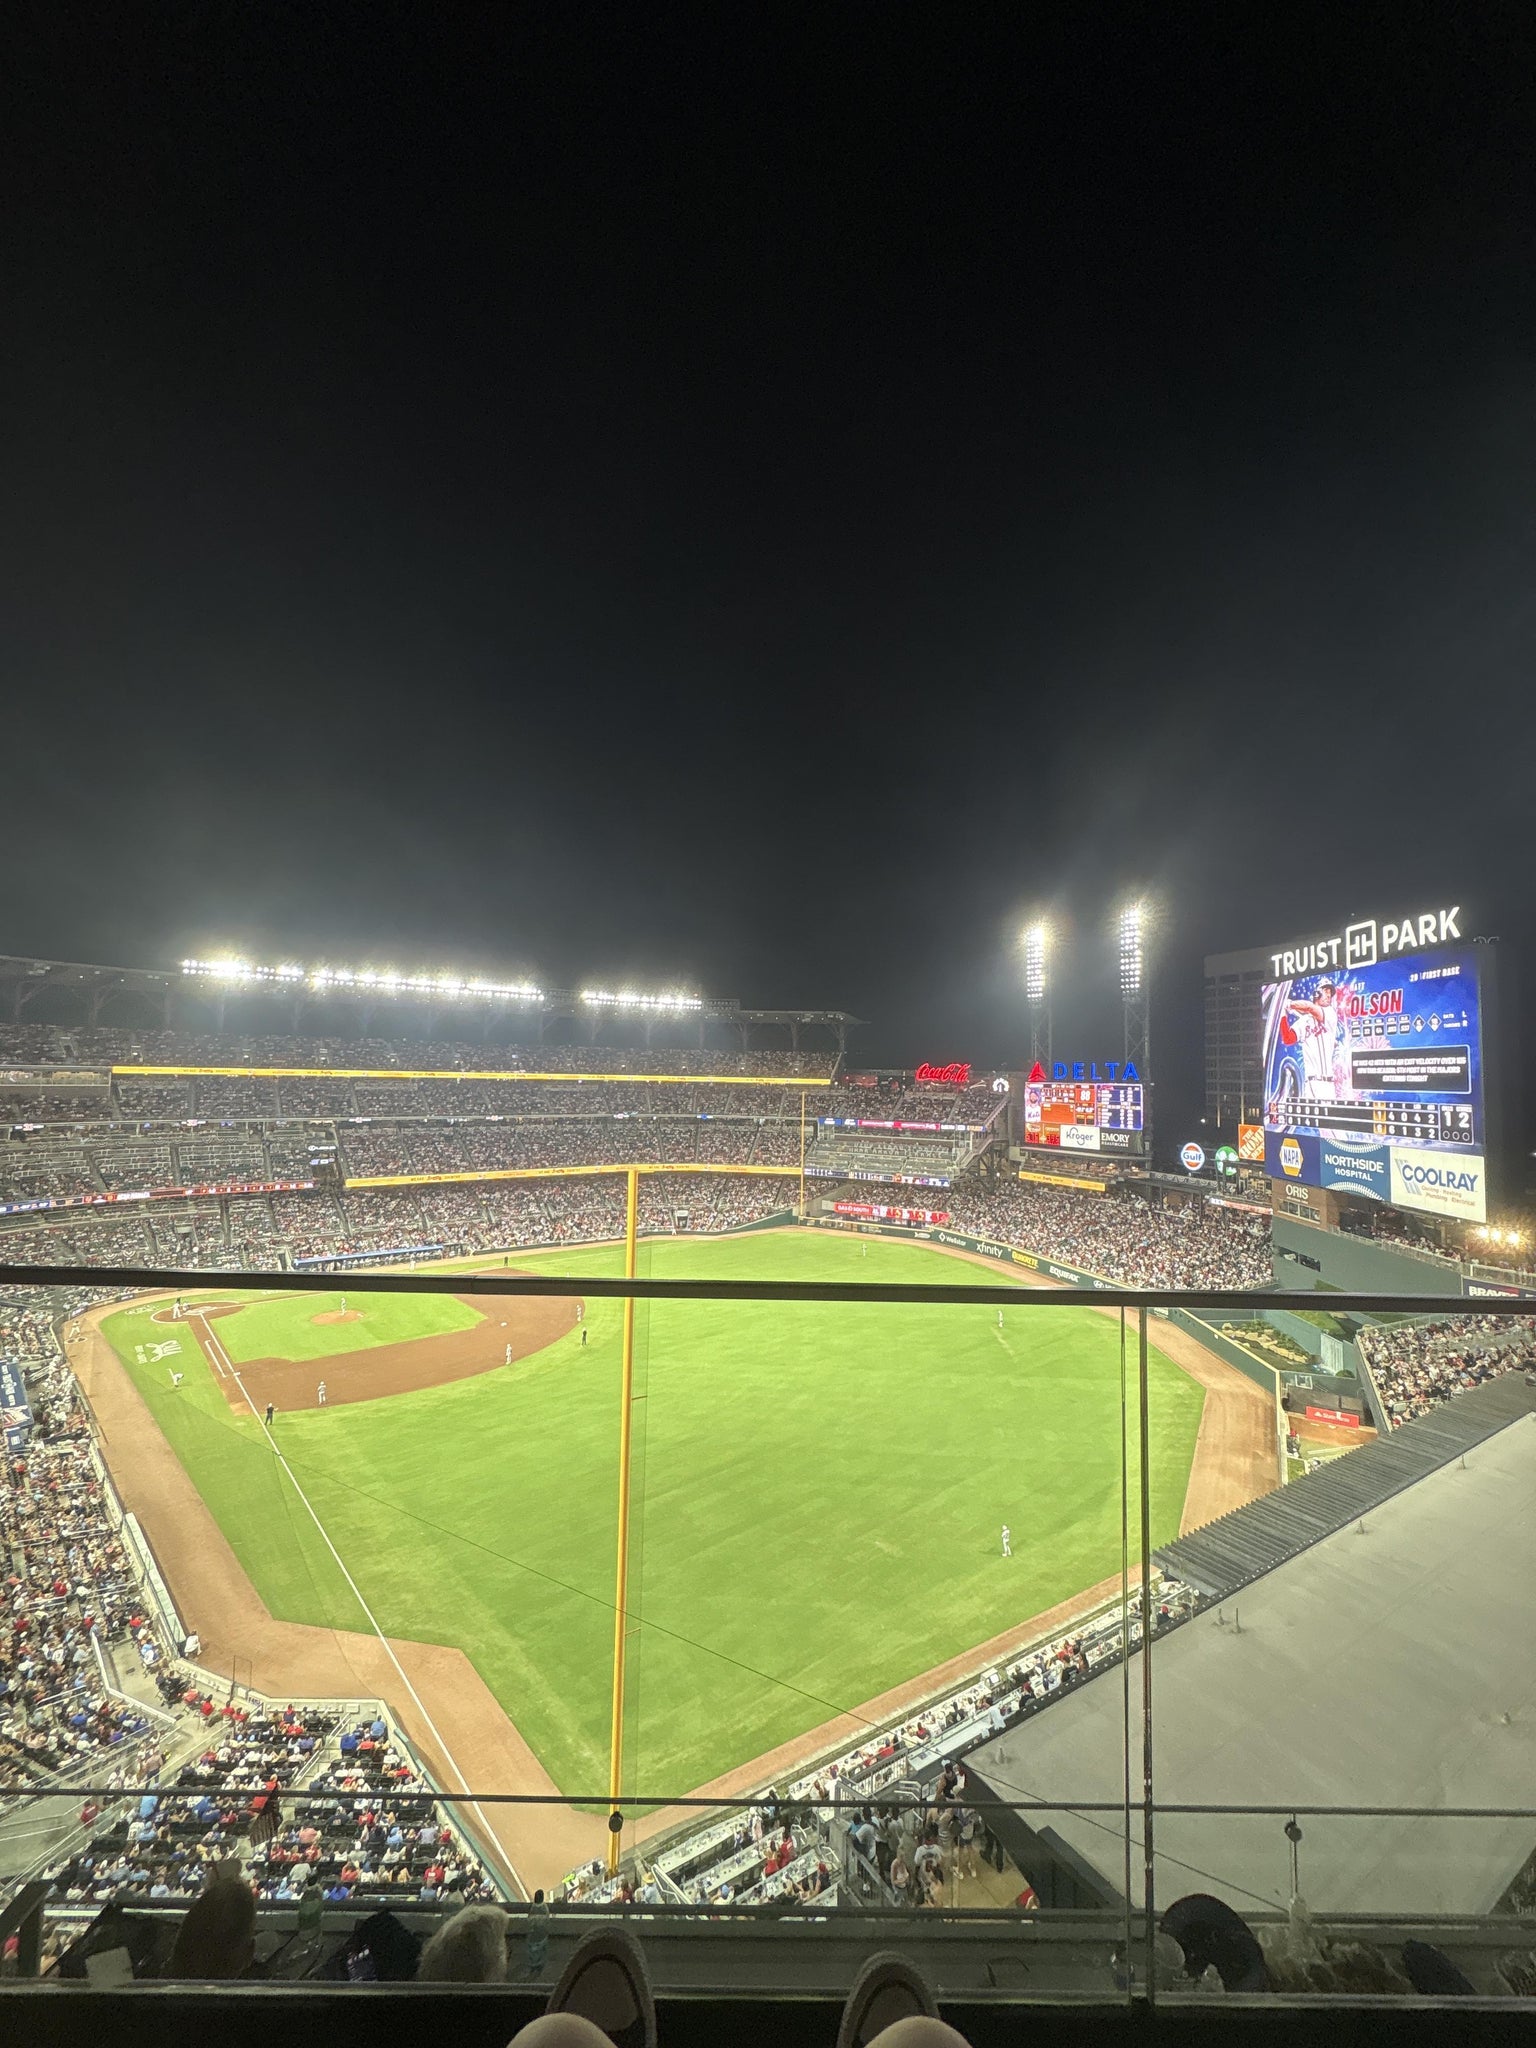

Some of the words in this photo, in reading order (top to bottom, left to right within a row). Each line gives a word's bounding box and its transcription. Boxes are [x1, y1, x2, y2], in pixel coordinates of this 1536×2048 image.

[1271, 938, 1342, 977] TRUIST
[1382, 906, 1462, 954] PARK
[1422, 969, 1441, 981] FIRST
[1442, 966, 1460, 977] BASE
[1350, 988, 1404, 1018] OLSON
[1462, 1010, 1467, 1018] L
[1053, 1062, 1139, 1081] DELTA
[1288, 1105, 1293, 1113] 0
[1296, 1105, 1301, 1114] 0
[1306, 1106, 1310, 1114] 0
[1314, 1106, 1319, 1115] 0
[1388, 1112, 1395, 1120] 4
[1401, 1112, 1407, 1121] 0
[1414, 1113, 1421, 1122] 4
[1428, 1114, 1435, 1123] 2
[1444, 1112, 1451, 1126] 1
[1459, 1112, 1470, 1128] 2
[1288, 1116, 1293, 1124] 0
[1389, 1126, 1395, 1134] 6
[1402, 1126, 1407, 1136] 1
[1415, 1128, 1421, 1137] 3
[1428, 1128, 1435, 1138] 2
[1066, 1127, 1094, 1146] Kroger
[1101, 1132, 1130, 1143] EMORY
[1183, 1152, 1203, 1161] Gulf
[1283, 1148, 1300, 1166] NAPA
[1324, 1153, 1385, 1174] NORTHSIDE
[1334, 1167, 1373, 1182] HOSPITAL
[1402, 1164, 1479, 1193] COOLRAY
[1286, 1184, 1309, 1200] ORIS
[946, 1235, 967, 1246] Wellstar
[976, 1242, 1003, 1258] xfinity
[1050, 1266, 1080, 1283] EQUIFAX
